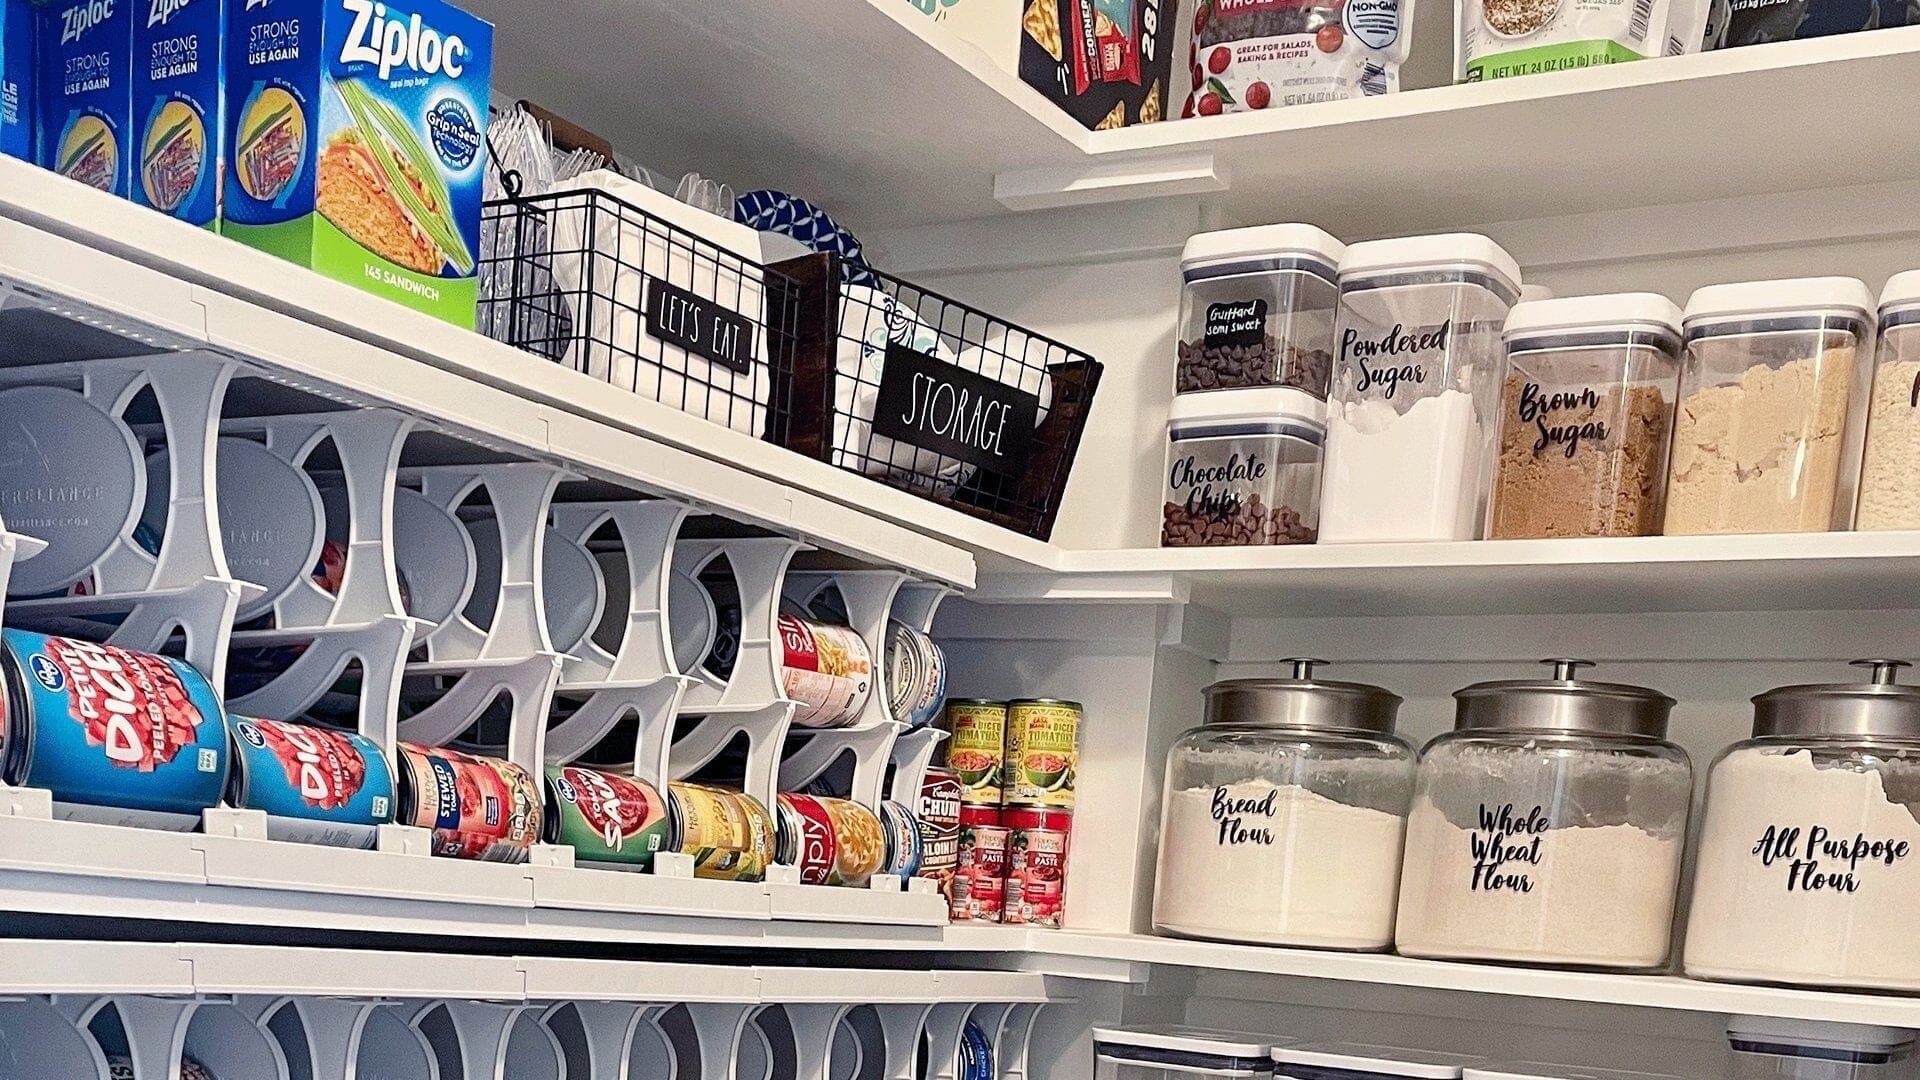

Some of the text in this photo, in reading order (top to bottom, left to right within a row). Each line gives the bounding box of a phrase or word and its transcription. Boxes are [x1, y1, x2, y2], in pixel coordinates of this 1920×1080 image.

[61, 0, 114, 46] Ziploc
[250, 19, 299, 42] STRONG
[340, 0, 465, 80] Ziploc
[151, 50, 197, 69] ENOUGH TO
[152, 34, 198, 58] STRONG
[249, 48, 299, 65] USE AGAIN
[250, 36, 299, 53] ENOUGH TO
[1237, 40, 1314, 54] GREAT FOR SALADS,
[1238, 53, 1267, 63] BAKING
[1276, 50, 1309, 60] RECIPES
[65, 52, 110, 74] STRONG
[151, 61, 198, 80] USE AGAIN
[1492, 66, 1510, 79] NET
[1531, 62, 1542, 73] 24
[1544, 60, 1557, 72] OZ
[64, 77, 110, 95] USE AGAIN
[427, 111, 480, 146] Grip'n Seal
[433, 126, 474, 155] Technology
[363, 264, 440, 302] 145 SANDWICH
[659, 289, 744, 365] LET'S EAT.
[1207, 317, 1263, 336] semi sweet
[1210, 302, 1256, 321] Guittard
[1340, 320, 1451, 362] Powdered
[1357, 357, 1428, 399] Sugar
[902, 371, 1012, 456] STORAGE
[1518, 383, 1600, 422] Brown
[1533, 414, 1611, 459] Sugar
[1170, 452, 1267, 490] Chocolate
[1185, 484, 1243, 523] Chips
[59, 646, 100, 719] PETITE
[147, 702, 168, 761] PEELED
[325, 752, 343, 798] PEELED
[433, 763, 451, 819] STEWED
[447, 771, 458, 812] TOMATOES
[578, 774, 602, 820] TOMATO
[1210, 785, 1277, 819] Bread
[1218, 816, 1276, 846] Flour
[1479, 802, 1551, 835] Whole
[982, 853, 1004, 863] PASTE
[1034, 856, 1058, 867] PASTE
[1470, 832, 1543, 865] Wheat
[1752, 824, 1910, 871] All Purpose
[1470, 860, 1535, 893] Flour
[1787, 857, 1861, 892] Flour
